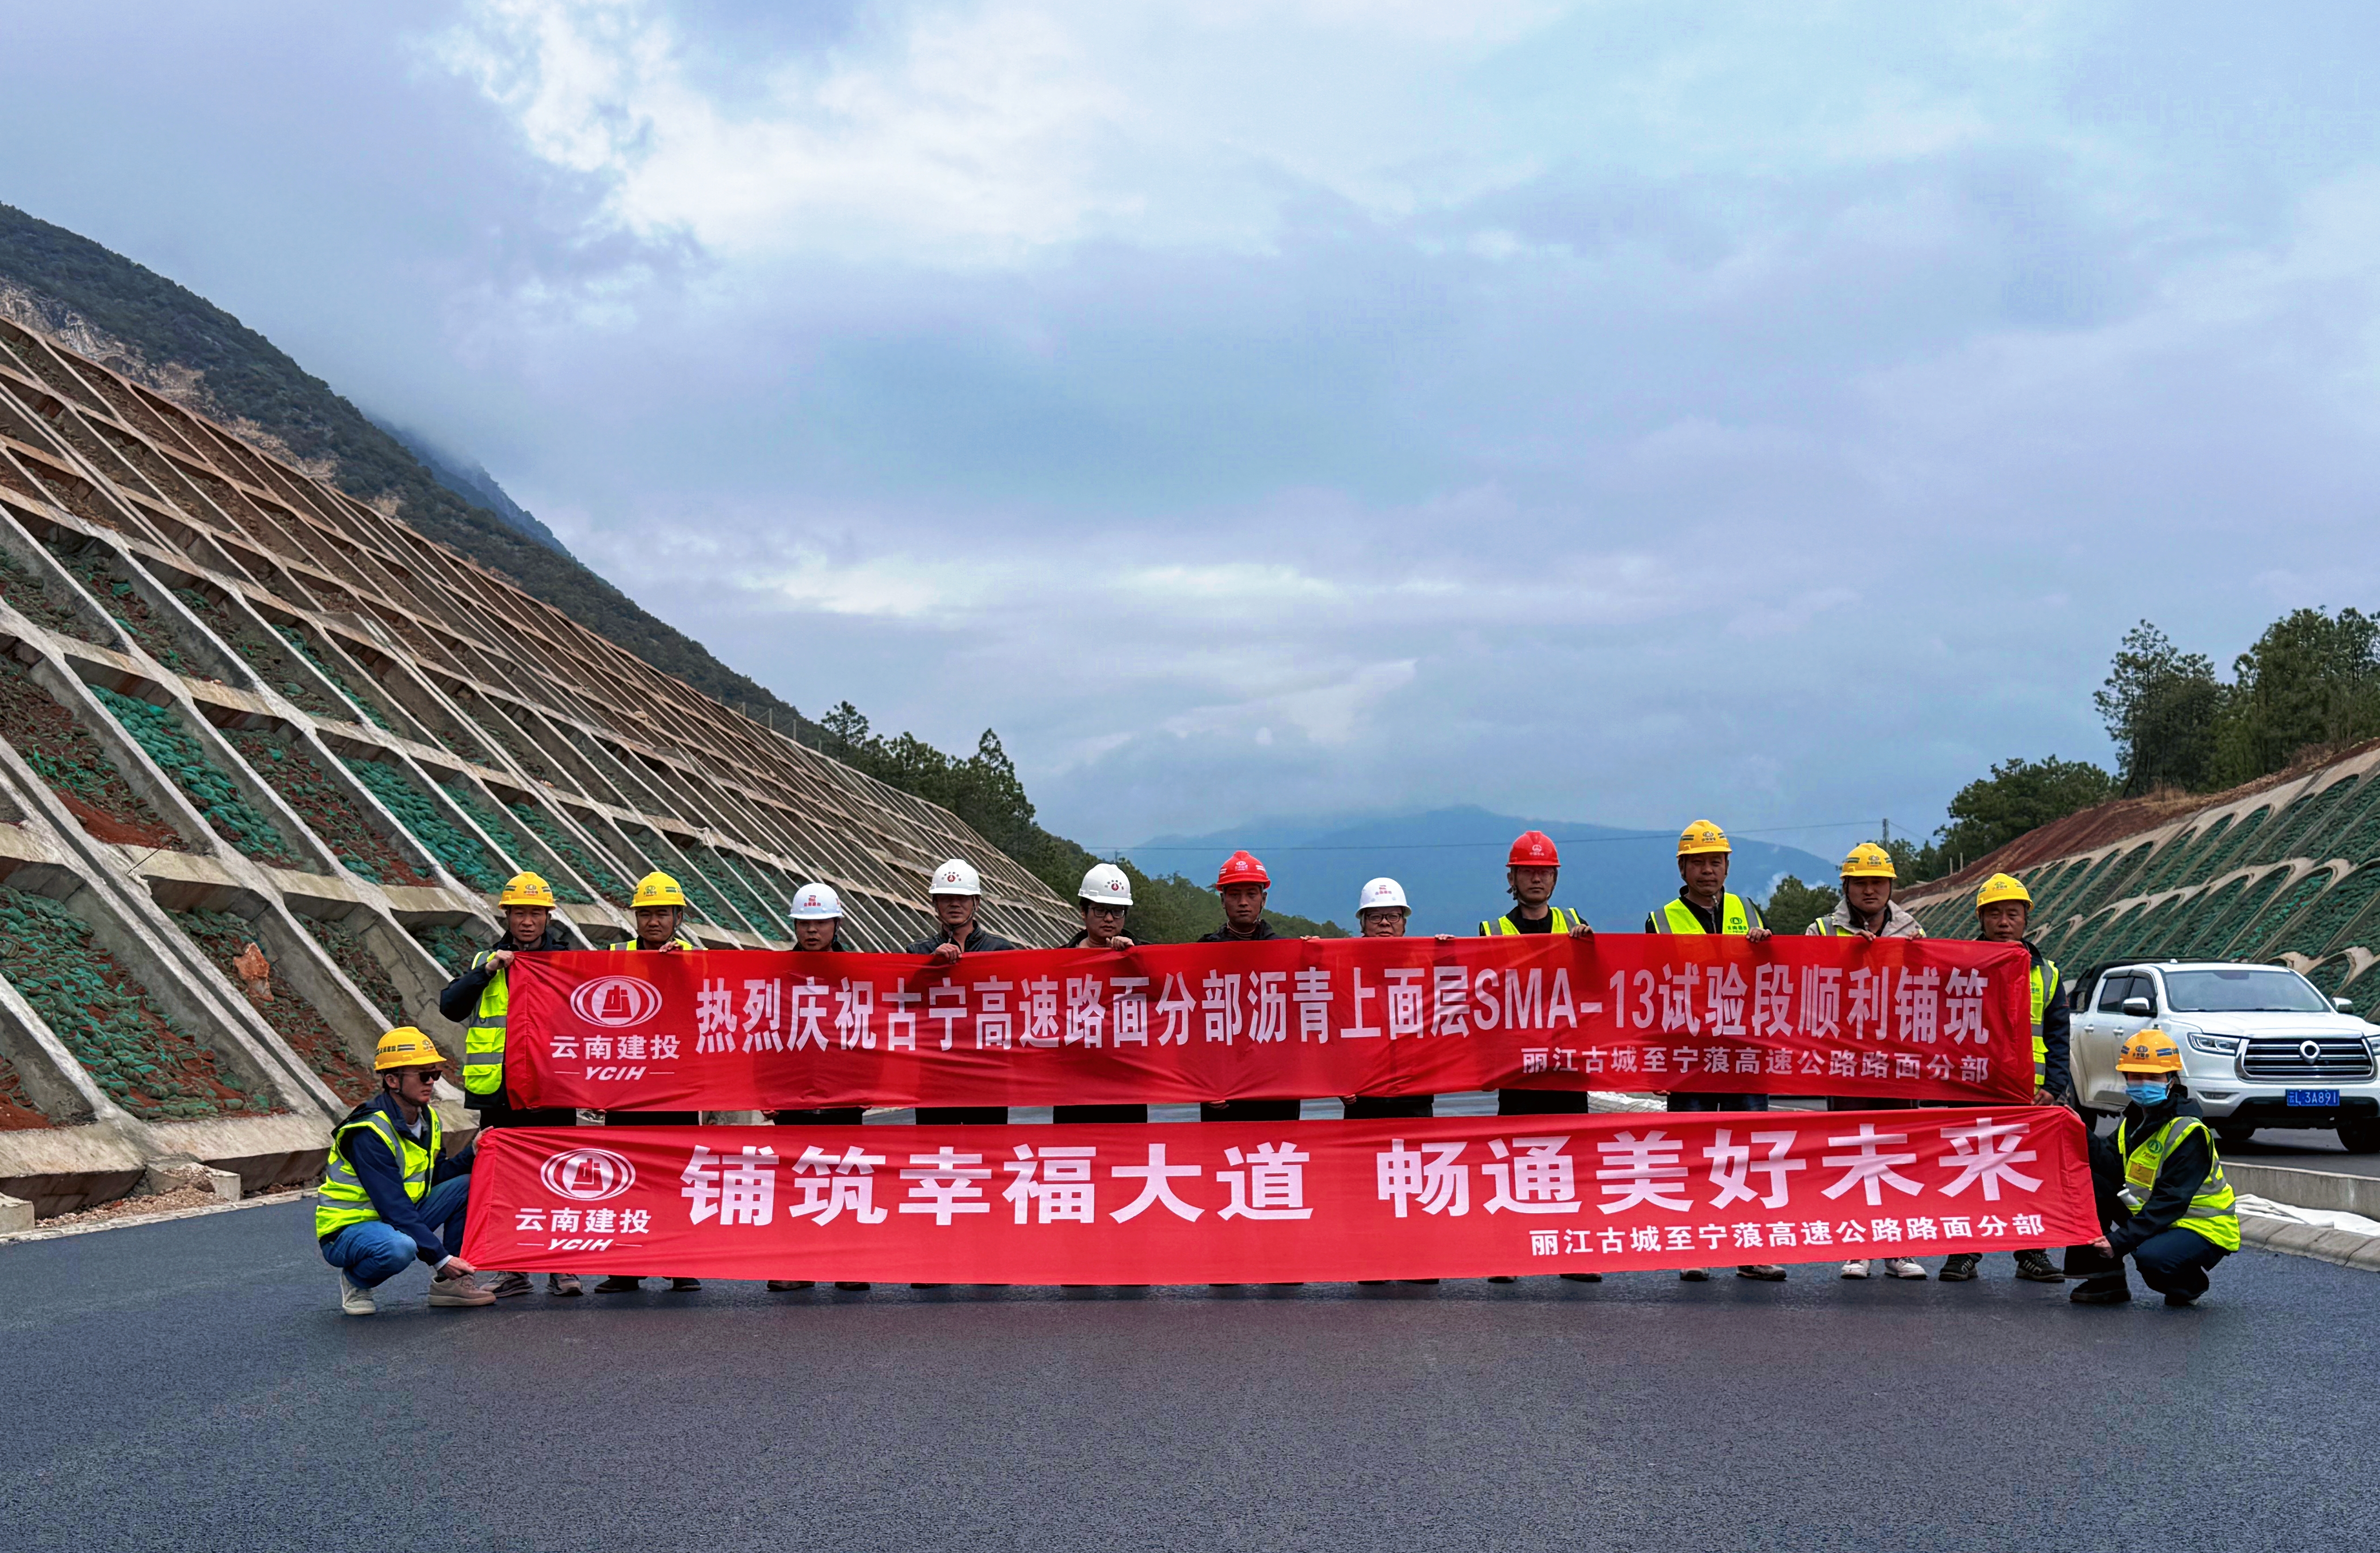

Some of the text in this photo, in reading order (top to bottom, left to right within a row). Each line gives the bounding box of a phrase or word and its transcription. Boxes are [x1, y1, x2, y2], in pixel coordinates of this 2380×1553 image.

[696, 962, 1989, 1054] 热烈庆祝古宁高速路面分部沥青上面层SMA-13试验段顺利铺筑
[550, 1035, 681, 1060] 云南建投
[585, 1066, 647, 1081] YCIH
[1521, 1046, 1989, 1083] 丽江古城至宁蒗高速公路路面分部
[680, 1117, 2043, 1226] 铺筑幸福大道 畅通美好未来
[515, 1208, 651, 1234] 云南建投
[1529, 1213, 2045, 1256] 丽江古城至宁蒗高速公路路面分部
[548, 1238, 614, 1252] YCIH
